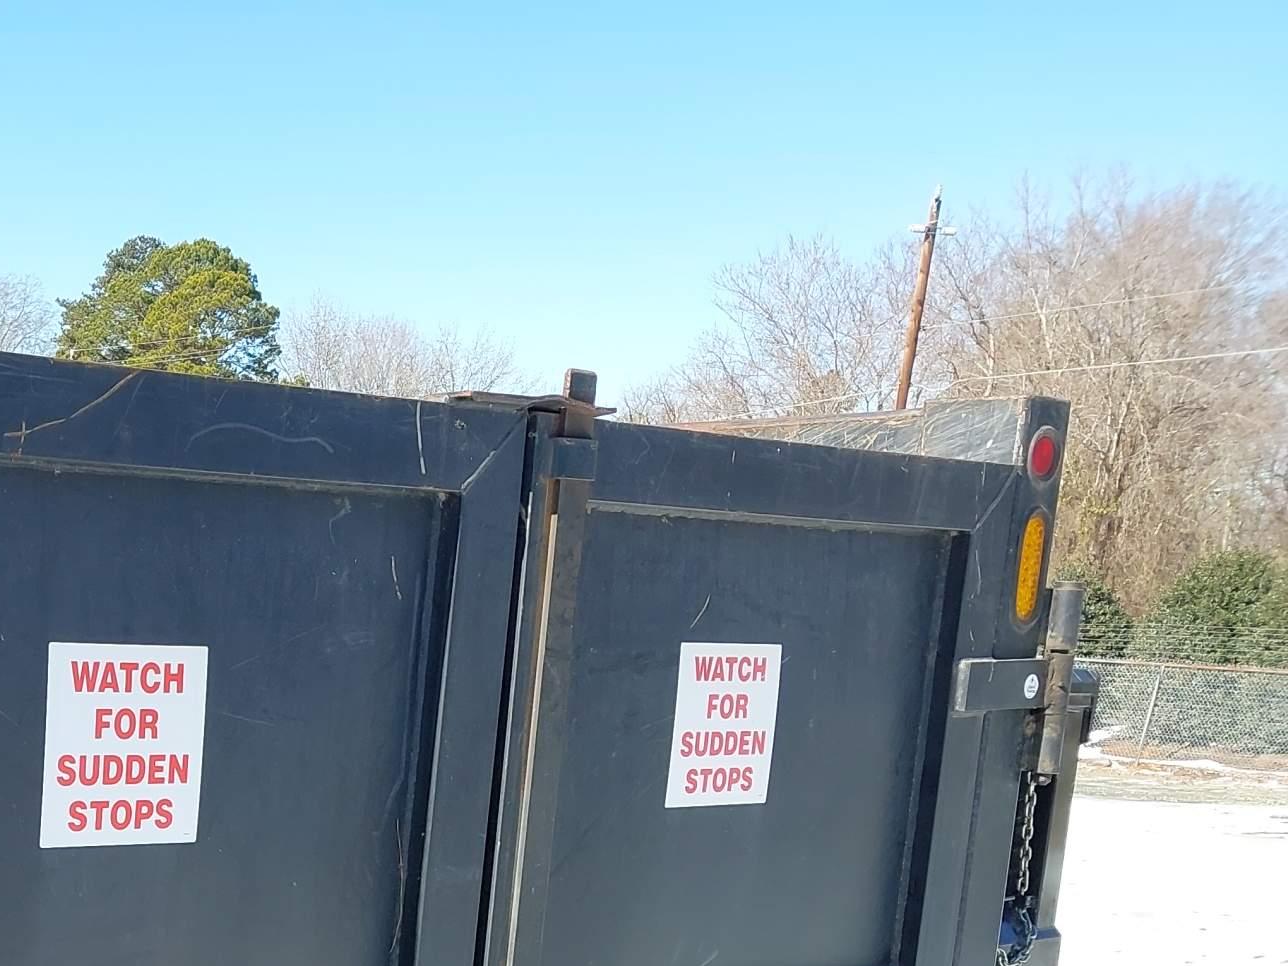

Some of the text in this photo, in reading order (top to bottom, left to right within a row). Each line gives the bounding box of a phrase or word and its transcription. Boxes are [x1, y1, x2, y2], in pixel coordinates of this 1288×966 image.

[70, 660, 185, 694] WATCH
[694, 655, 767, 682] WATCH
[706, 693, 749, 720] FOR
[94, 708, 160, 740] FOR
[679, 730, 766, 758] SUDDEN
[56, 754, 189, 787] SUDDEN
[684, 766, 754, 794] STOPS
[67, 798, 174, 832] STOPS
